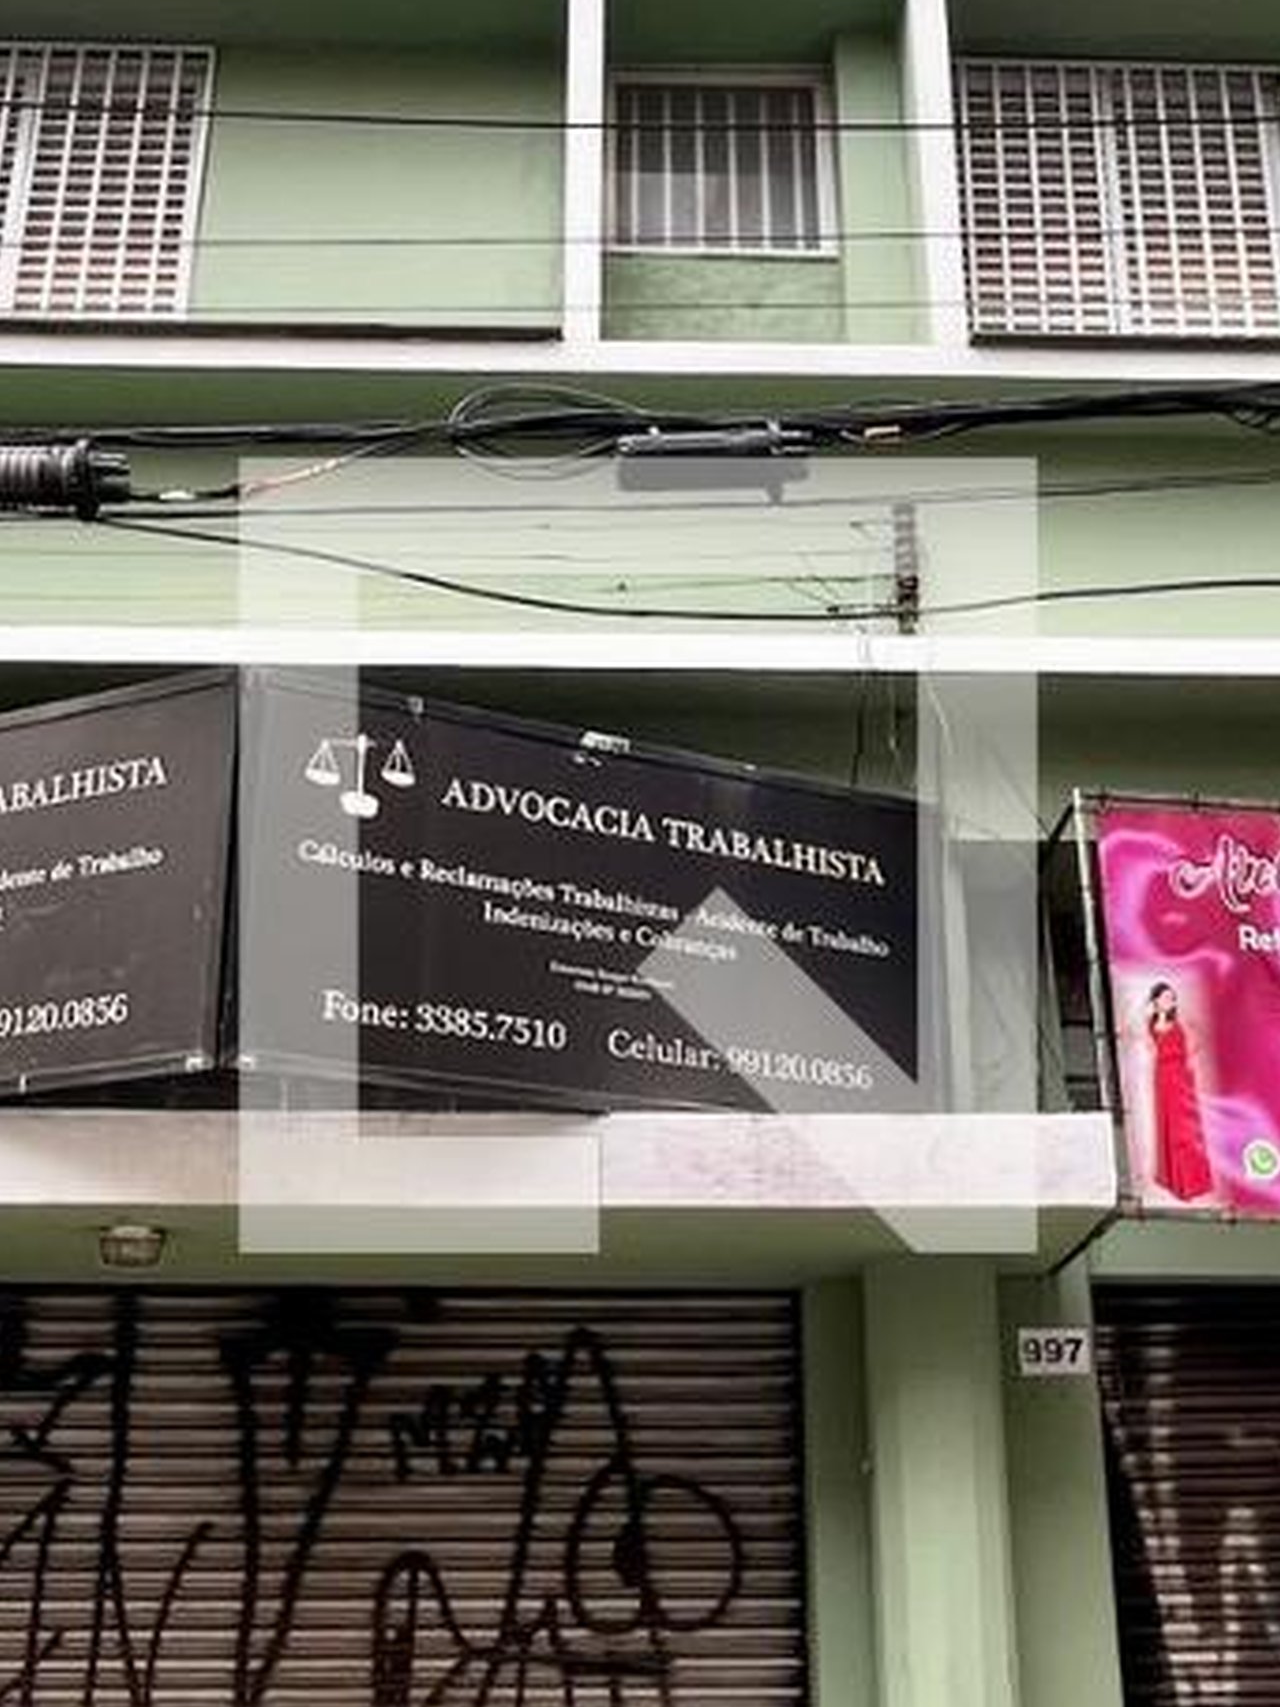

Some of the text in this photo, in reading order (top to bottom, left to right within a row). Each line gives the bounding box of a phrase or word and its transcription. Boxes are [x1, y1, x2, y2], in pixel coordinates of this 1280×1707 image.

[441, 778, 886, 885] ADVOCACIA TRABALHISTA
[400, 862, 415, 879] e
[323, 990, 875, 1091] Fone: 3385.7510 Celular: 99120.0856
[1023, 1336, 1084, 1365] 997
